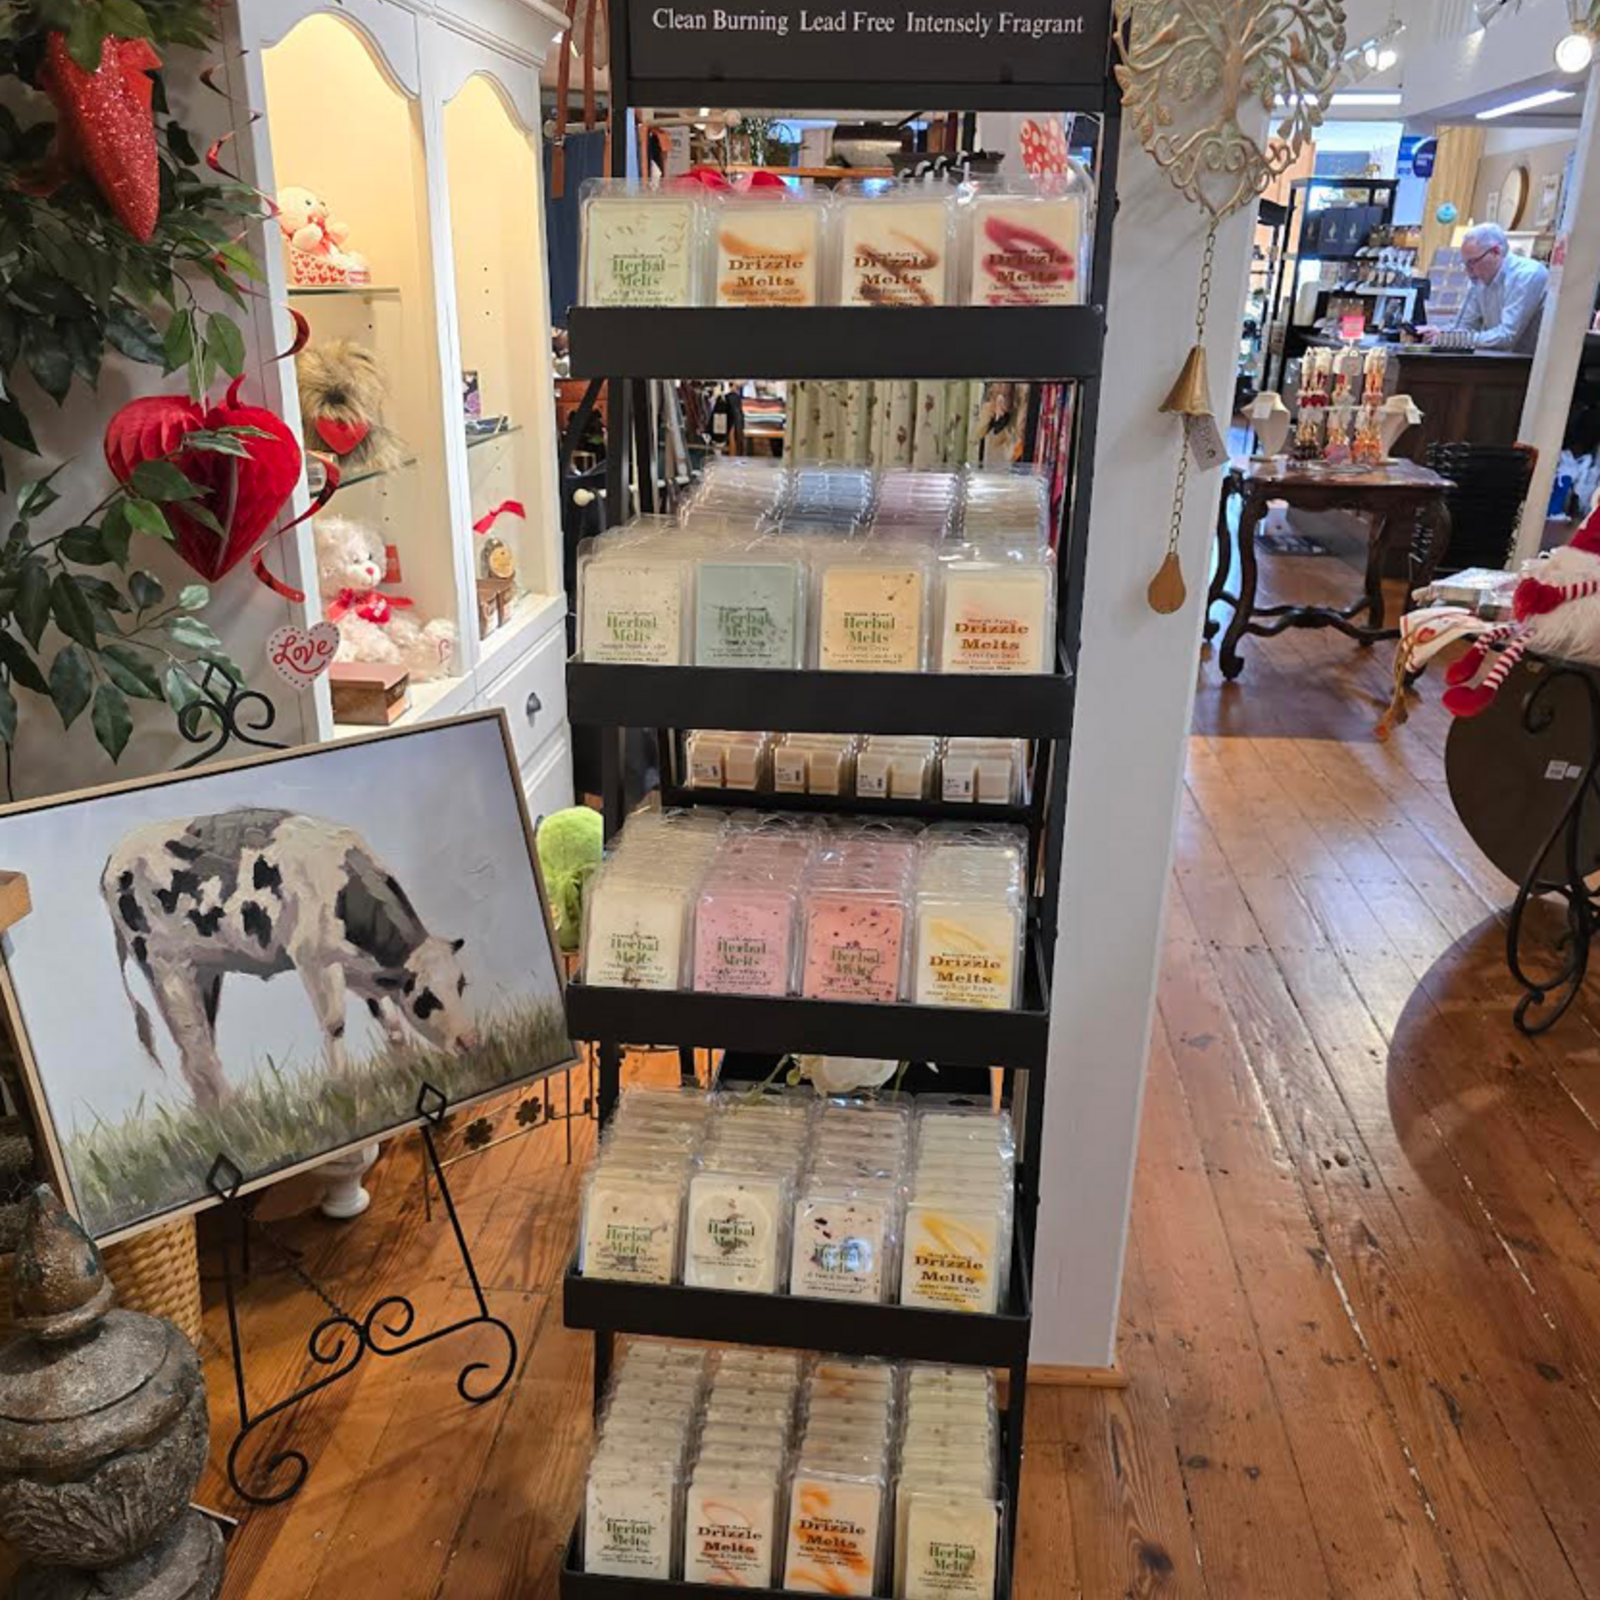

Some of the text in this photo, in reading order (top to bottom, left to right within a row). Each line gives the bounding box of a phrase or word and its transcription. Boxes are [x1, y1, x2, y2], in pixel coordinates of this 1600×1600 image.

[652, 9, 1084, 38] Clean Burning Lead Free Intensely Fragrant
[728, 259, 804, 271] Drizzle
[854, 256, 936, 268] Drizzle
[988, 253, 1068, 264] Drizzle
[612, 259, 666, 272] Herbal
[617, 273, 661, 287] Melts
[737, 276, 795, 286] Melts
[863, 273, 922, 285] Melts
[997, 271, 1058, 283] Melts
[607, 615, 657, 628] Herbal
[719, 611, 769, 625] Herbal
[843, 617, 895, 629] Herbal
[955, 623, 1029, 634] Drizzle
[611, 629, 651, 642] Melts
[847, 631, 889, 643] Melts
[961, 639, 1020, 650] Melts
[272, 634, 333, 674] Love
[611, 938, 659, 951] Herbal
[717, 942, 766, 954] Herbal
[929, 956, 1001, 969] Drizzle
[935, 971, 993, 984] Melts
[605, 1229, 652, 1242] Herbal
[707, 1223, 755, 1236] Herbal
[915, 1256, 983, 1270] Drizzle
[920, 1271, 976, 1284] Melts
[606, 1522, 652, 1535] Herbal
[697, 1527, 762, 1541] Drizzle
[800, 1519, 866, 1536] Drizzle
[612, 1534, 650, 1547] Melts
[806, 1535, 857, 1549] Melts
[703, 1541, 755, 1554] Melts
[929, 1546, 976, 1561] Herbal
